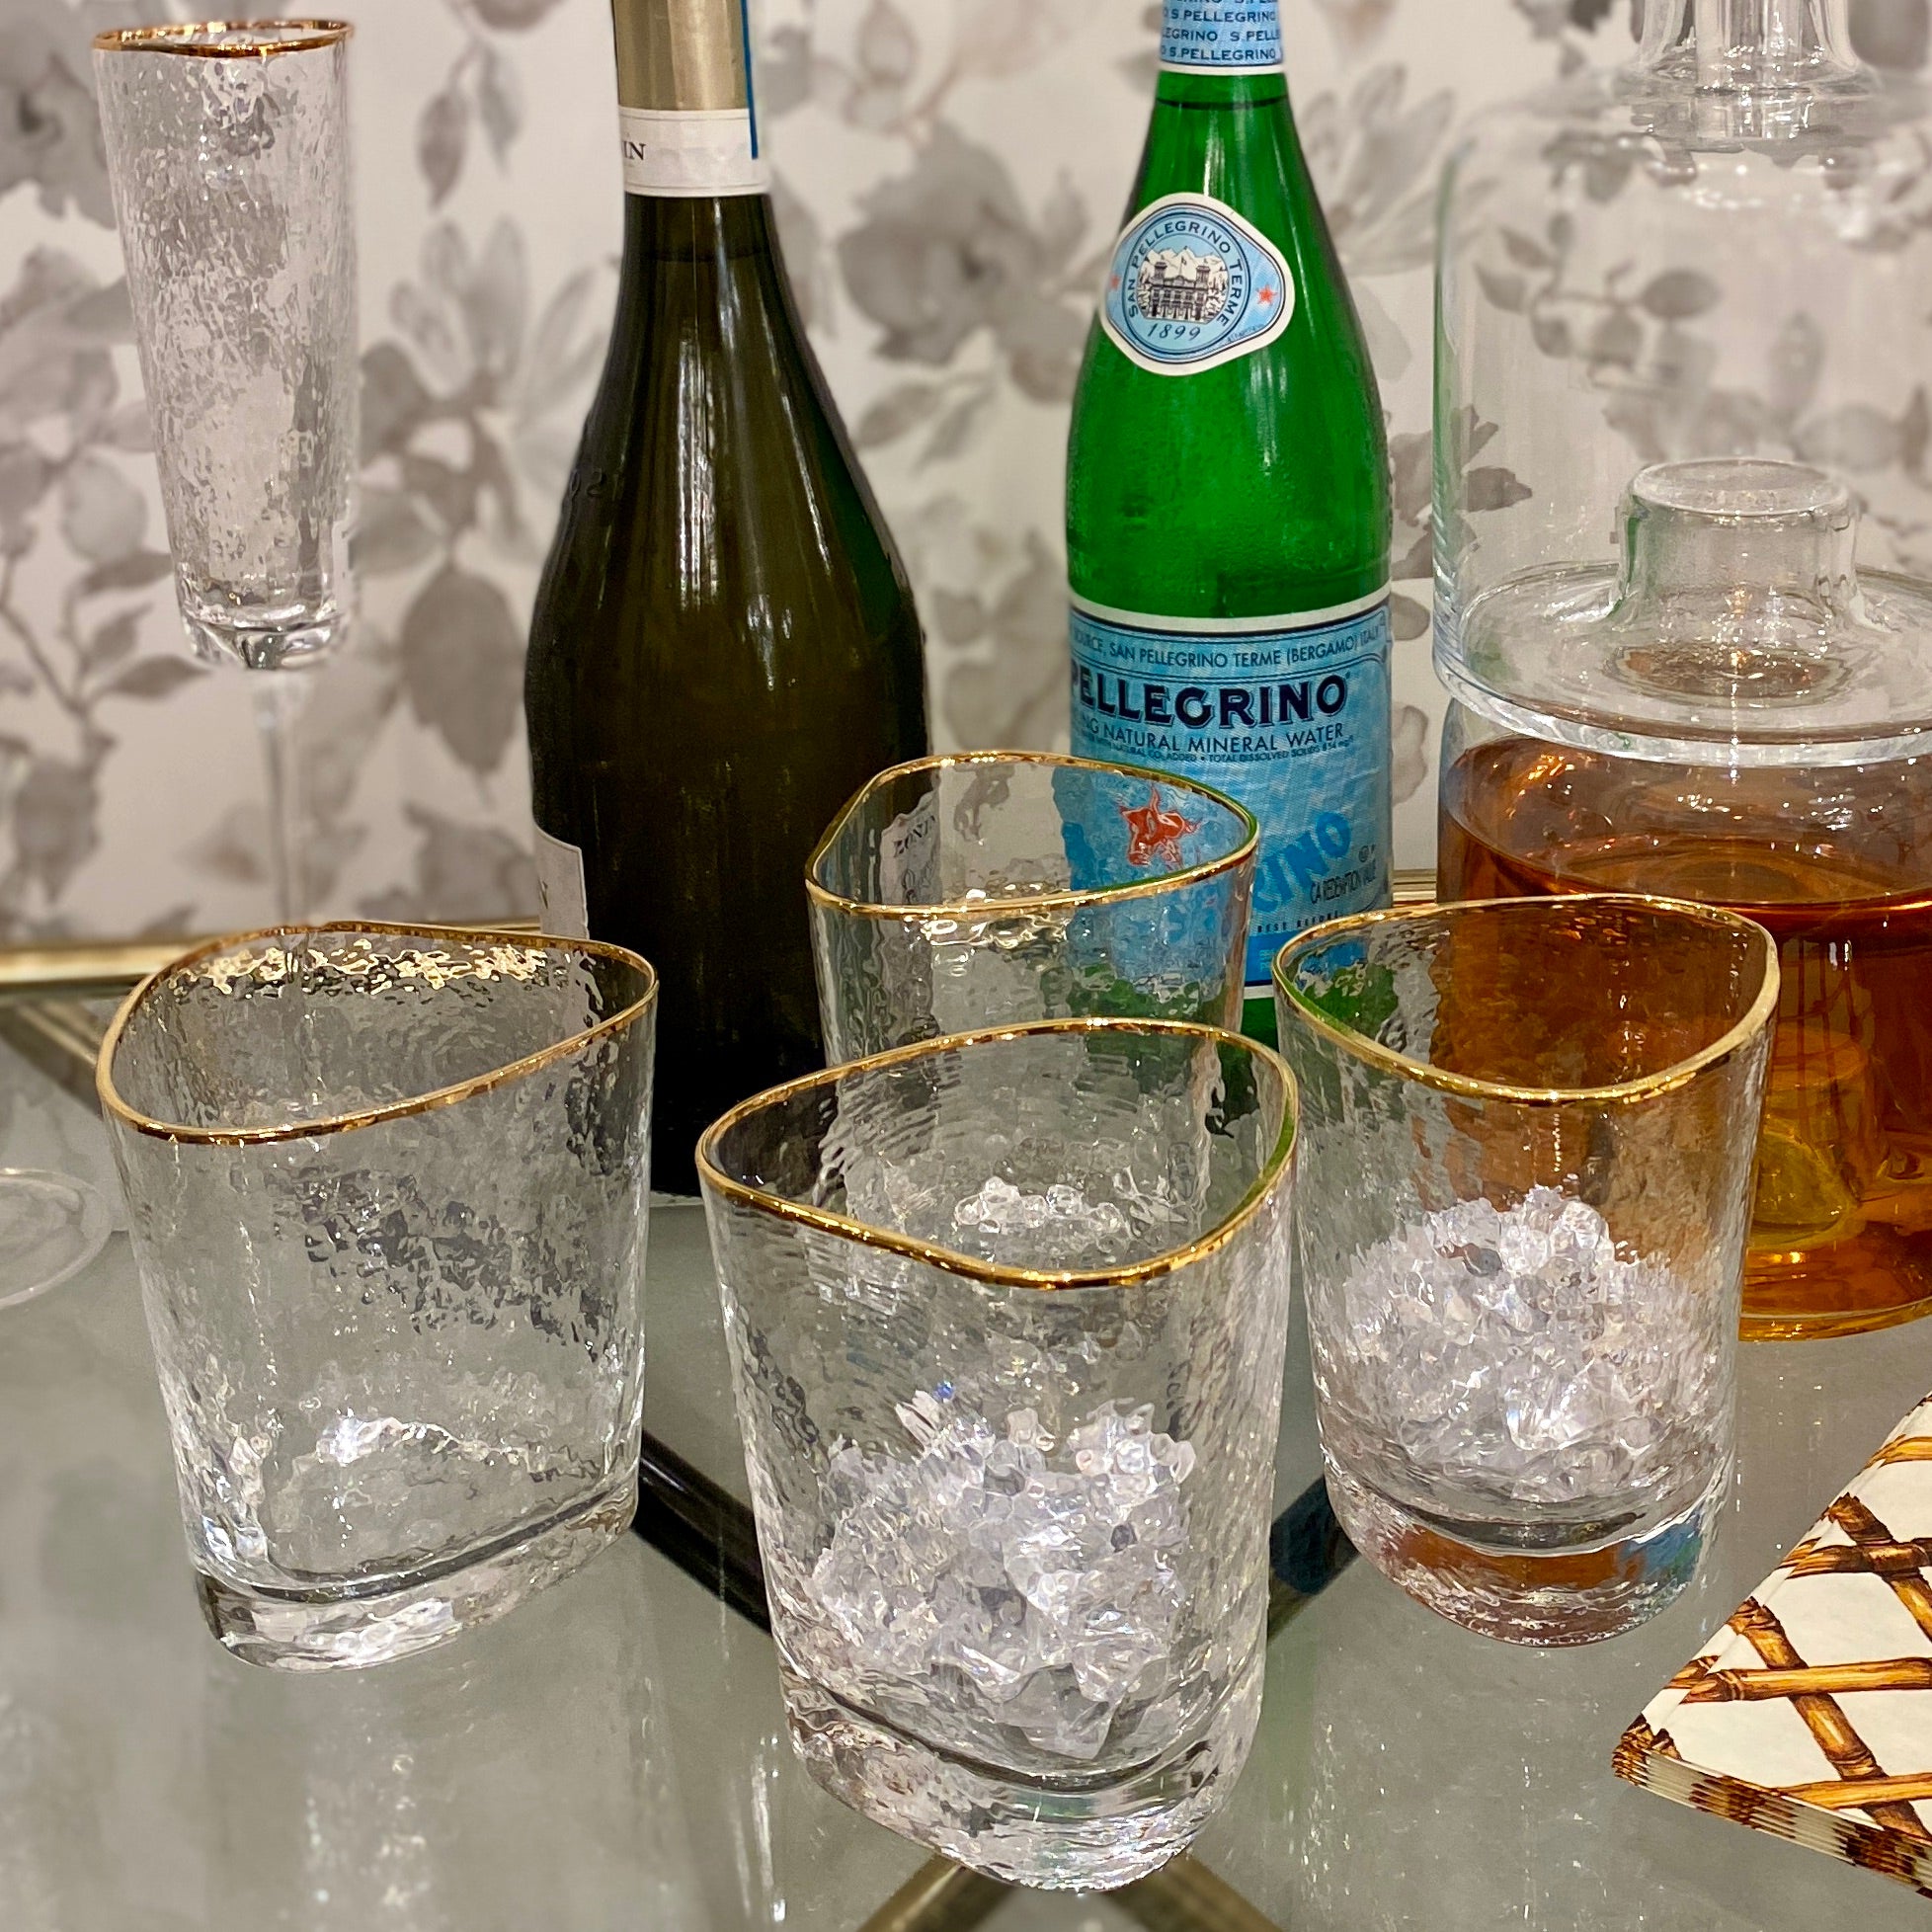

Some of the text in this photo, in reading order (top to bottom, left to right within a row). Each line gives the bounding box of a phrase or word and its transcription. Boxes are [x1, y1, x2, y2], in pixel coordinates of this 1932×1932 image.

[1128, 220, 1244, 327] SAN PELLEGRINO TERME
[1147, 323, 1201, 341] 1899
[1109, 641, 1135, 662] SAN
[1139, 647, 1229, 669] PELLEGRINO
[1233, 649, 1281, 668] TERME
[1286, 633, 1358, 666] (BERGAMO)
[1103, 723, 1180, 751] NATURAL
[1187, 734, 1278, 753] MINERAL
[1285, 722, 1343, 748] WATER
